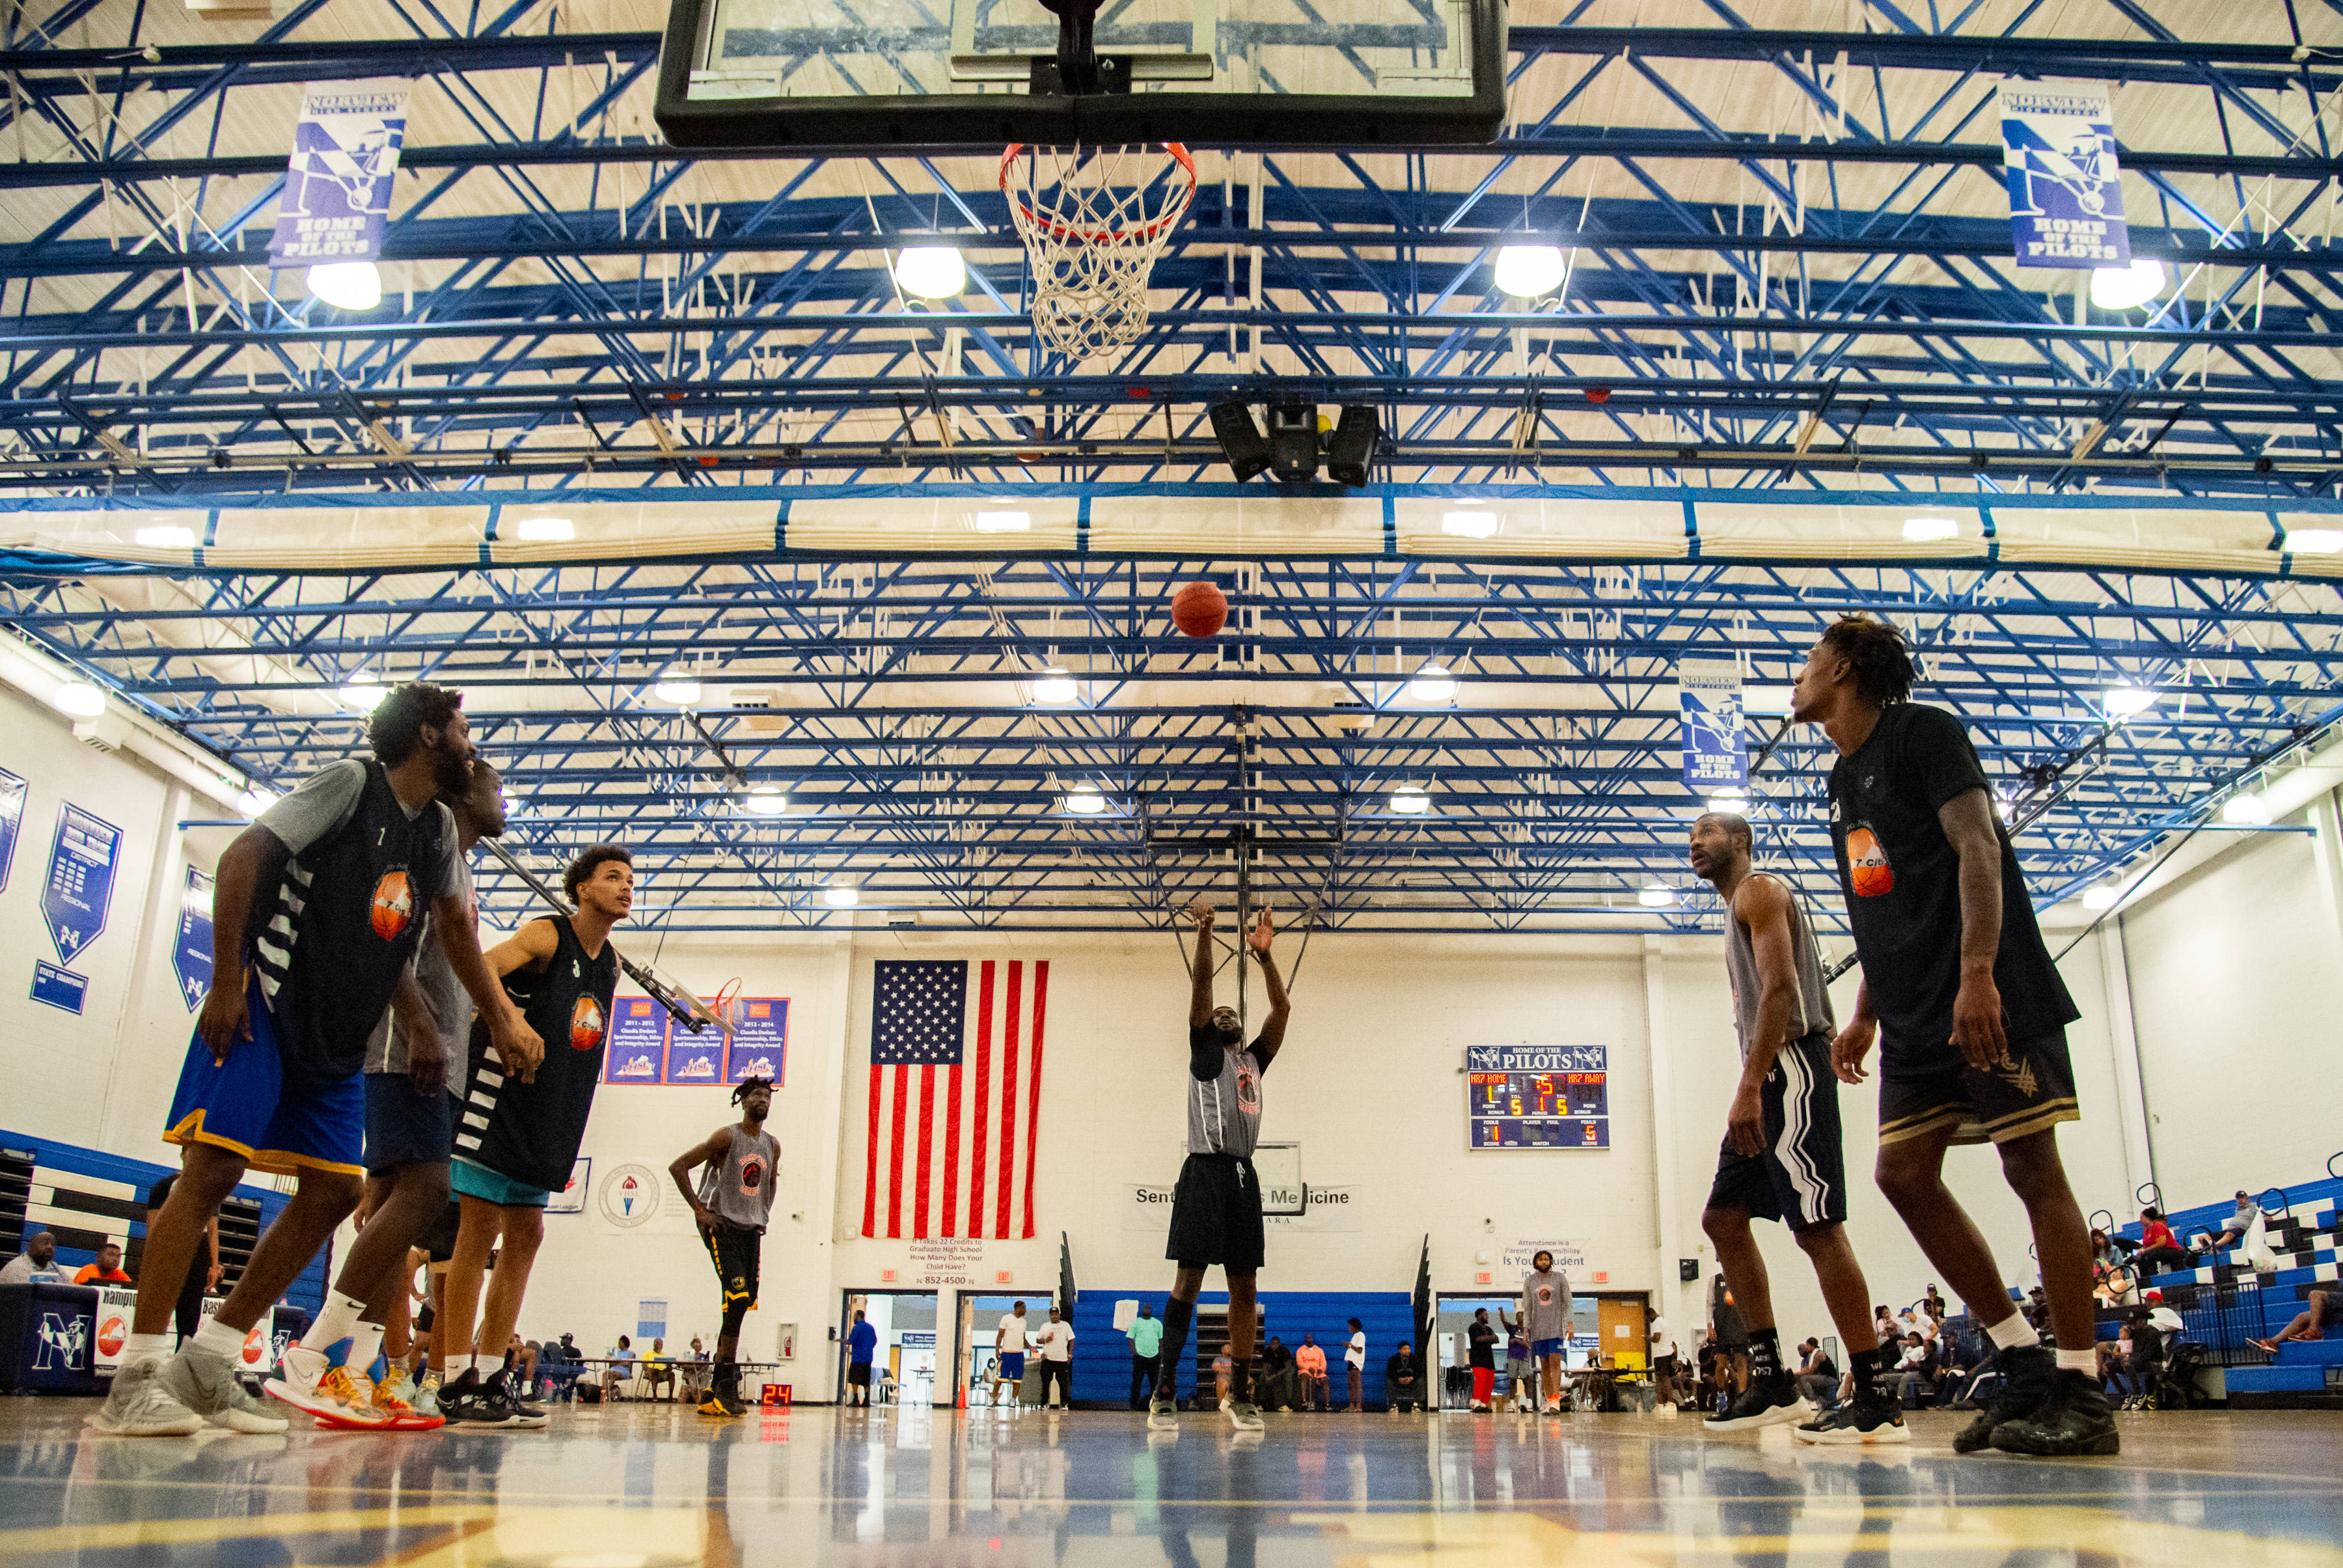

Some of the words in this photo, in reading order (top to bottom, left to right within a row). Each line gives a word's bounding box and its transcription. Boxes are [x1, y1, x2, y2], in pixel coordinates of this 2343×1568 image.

[307, 93, 407, 108] NORVIEW
[2003, 93, 2106, 110] NORVIEW
[295, 216, 366, 232] HOME
[2034, 218, 2107, 234] HOME
[301, 232, 323, 241] OF
[326, 231, 356, 240] THE
[2043, 232, 2066, 243] OF
[2068, 234, 2101, 244] THE
[283, 240, 369, 256] PILOTS
[2028, 242, 2118, 259] PILOTS
[1695, 754, 1735, 763] HOME
[1691, 769, 1740, 779] PILOTS
[377, 827, 385, 846] 1
[1503, 1054, 1572, 1069] PILOTS
[1470, 1073, 1485, 1084] HR7
[1487, 1073, 1507, 1084] HOME
[1568, 1073, 1583, 1083] HR7
[1584, 1073, 1606, 1083] AWAY
[1510, 1098, 1523, 1116] 5
[1539, 1096, 1545, 1112] 1
[1556, 1098, 1568, 1116] 5
[1271, 1190, 1349, 1204] Meicine
[1503, 1256, 1511, 1265] Is
[1515, 1256, 1533, 1265] You
[1554, 1256, 1584, 1265] udent
[1522, 1269, 1531, 1278] in
[1756, 1366, 1772, 1376] 757
[763, 1384, 790, 1405] 24
